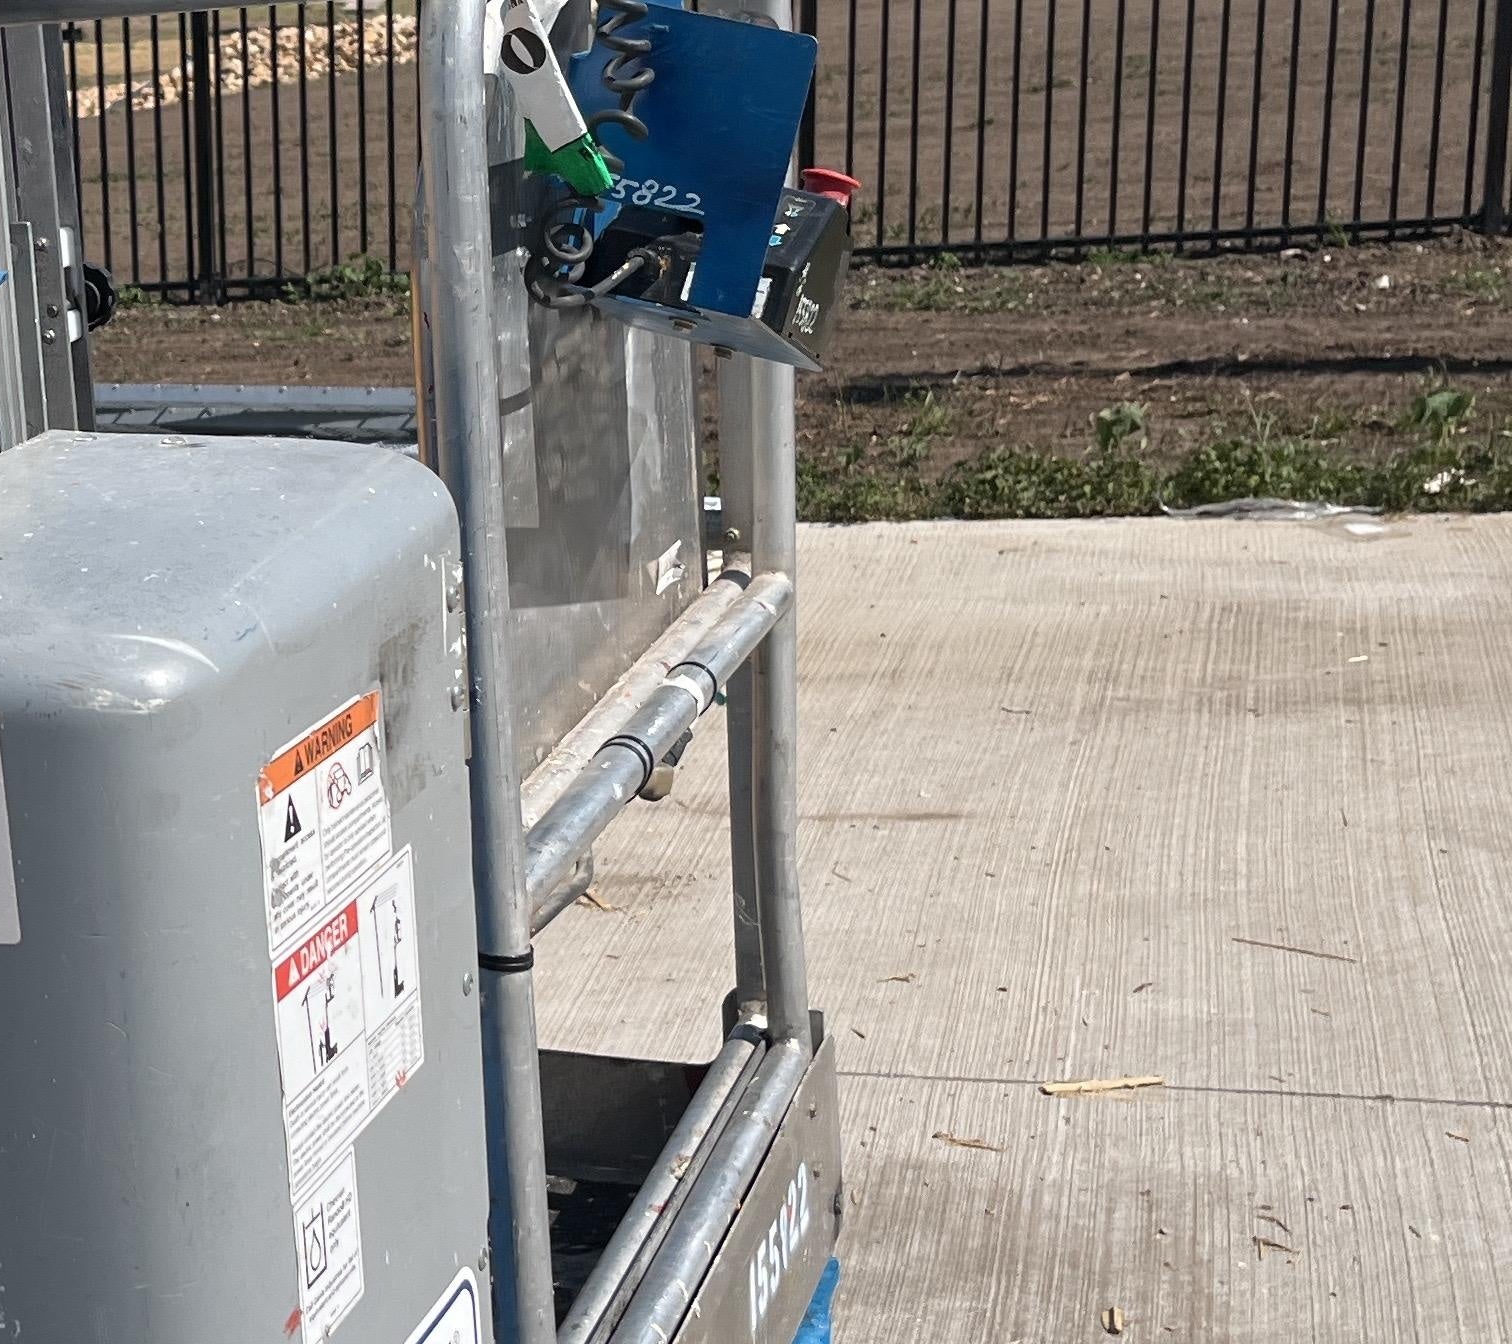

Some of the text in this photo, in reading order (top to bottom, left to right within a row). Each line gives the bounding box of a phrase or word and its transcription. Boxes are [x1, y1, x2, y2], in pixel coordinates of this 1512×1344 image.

[610, 173, 705, 216] 5822
[304, 713, 353, 765] WARNING
[299, 911, 350, 971] DANGER
